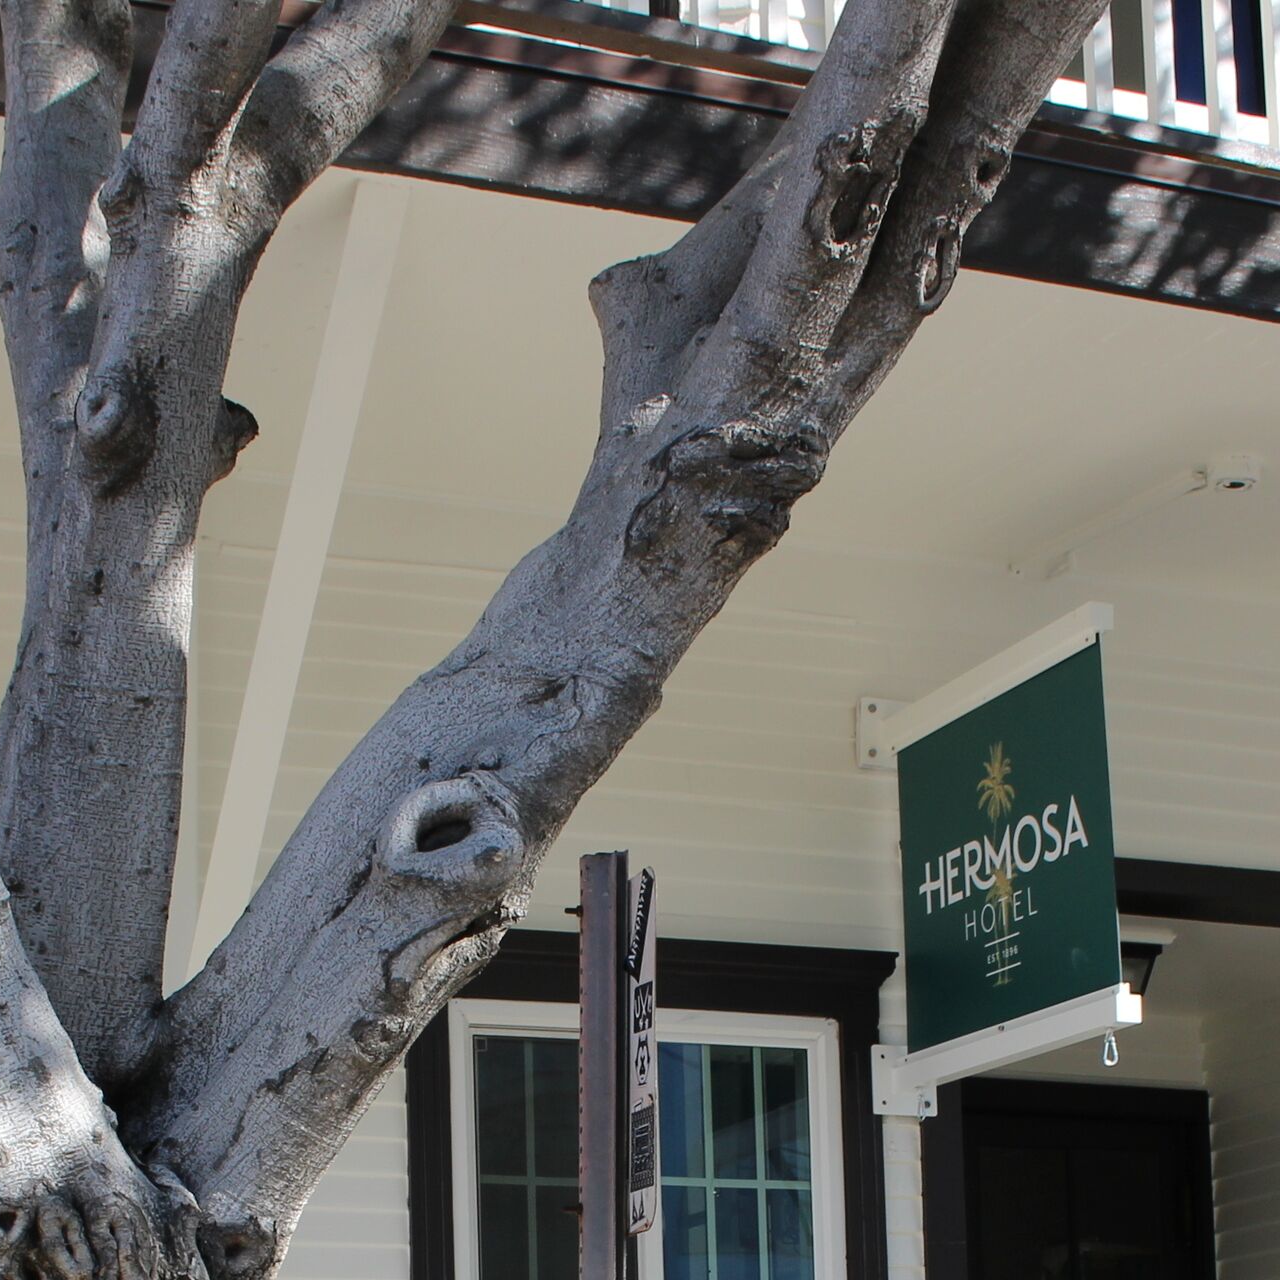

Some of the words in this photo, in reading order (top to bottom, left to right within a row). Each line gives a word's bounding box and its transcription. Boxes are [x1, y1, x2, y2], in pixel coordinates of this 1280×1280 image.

[919, 795, 1088, 915] HERMOSA
[965, 887, 1038, 941] HOTEL
[987, 951, 1000, 964] EST
